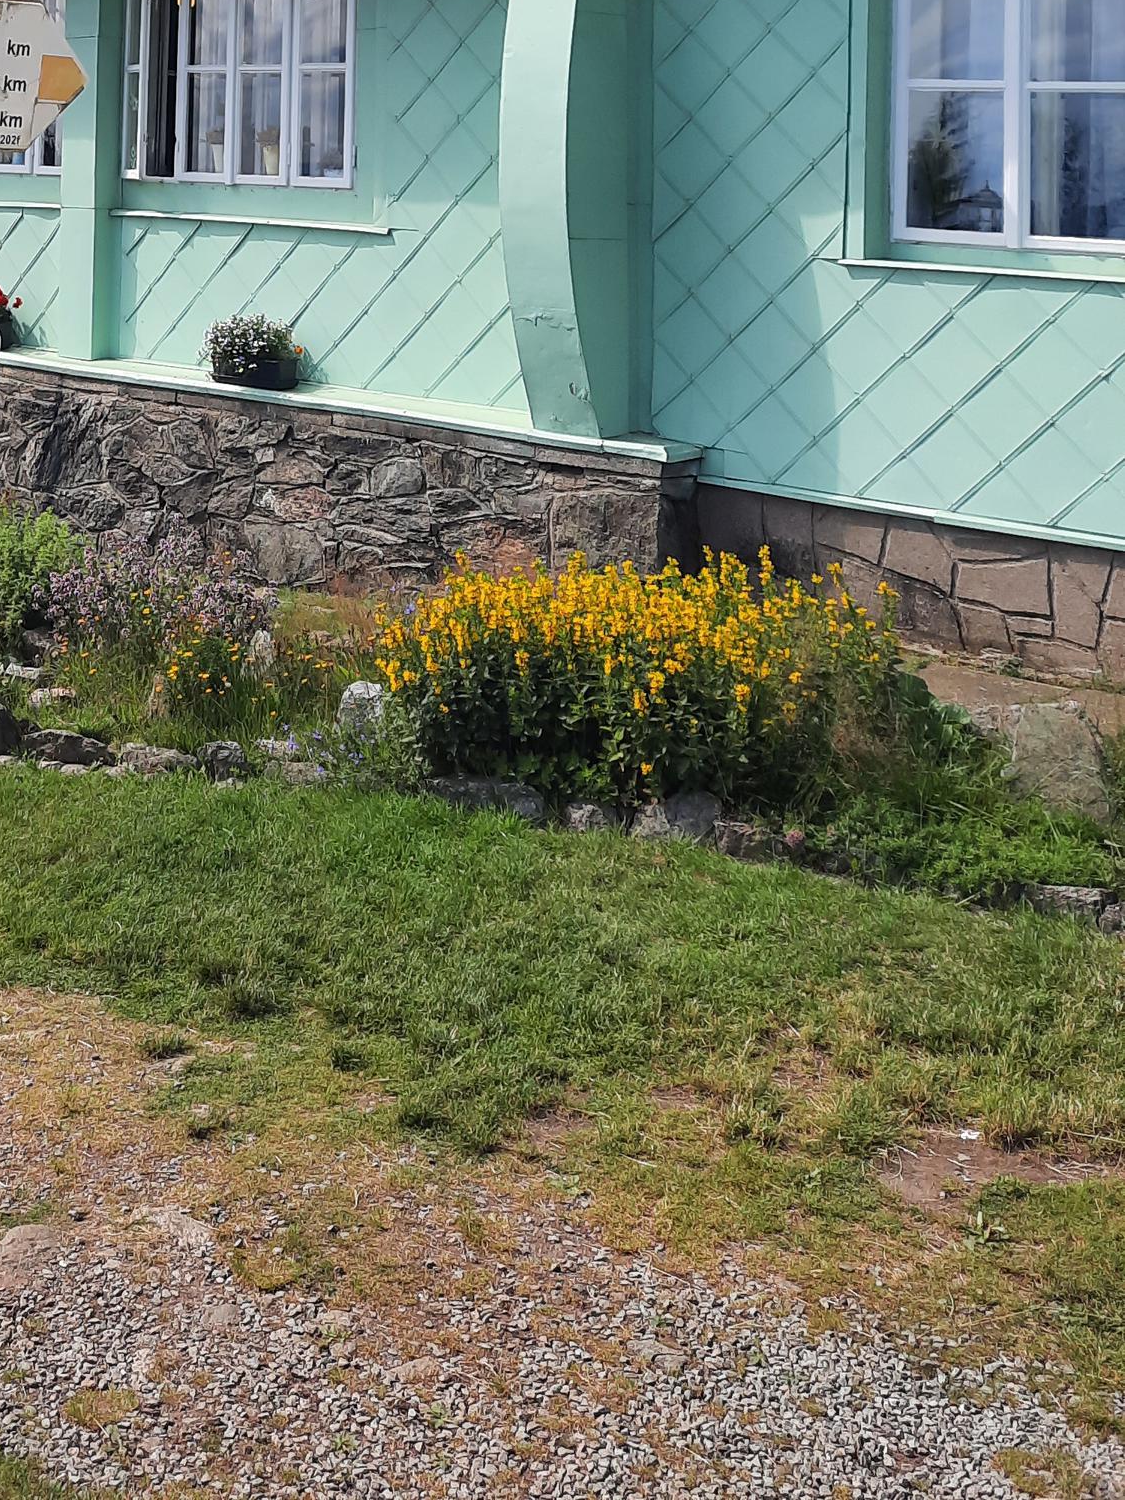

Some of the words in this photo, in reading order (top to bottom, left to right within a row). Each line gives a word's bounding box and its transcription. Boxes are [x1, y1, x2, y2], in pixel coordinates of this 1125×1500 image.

[7, 40, 30, 56] km
[3, 76, 26, 92] km
[0, 112, 22, 128] km
